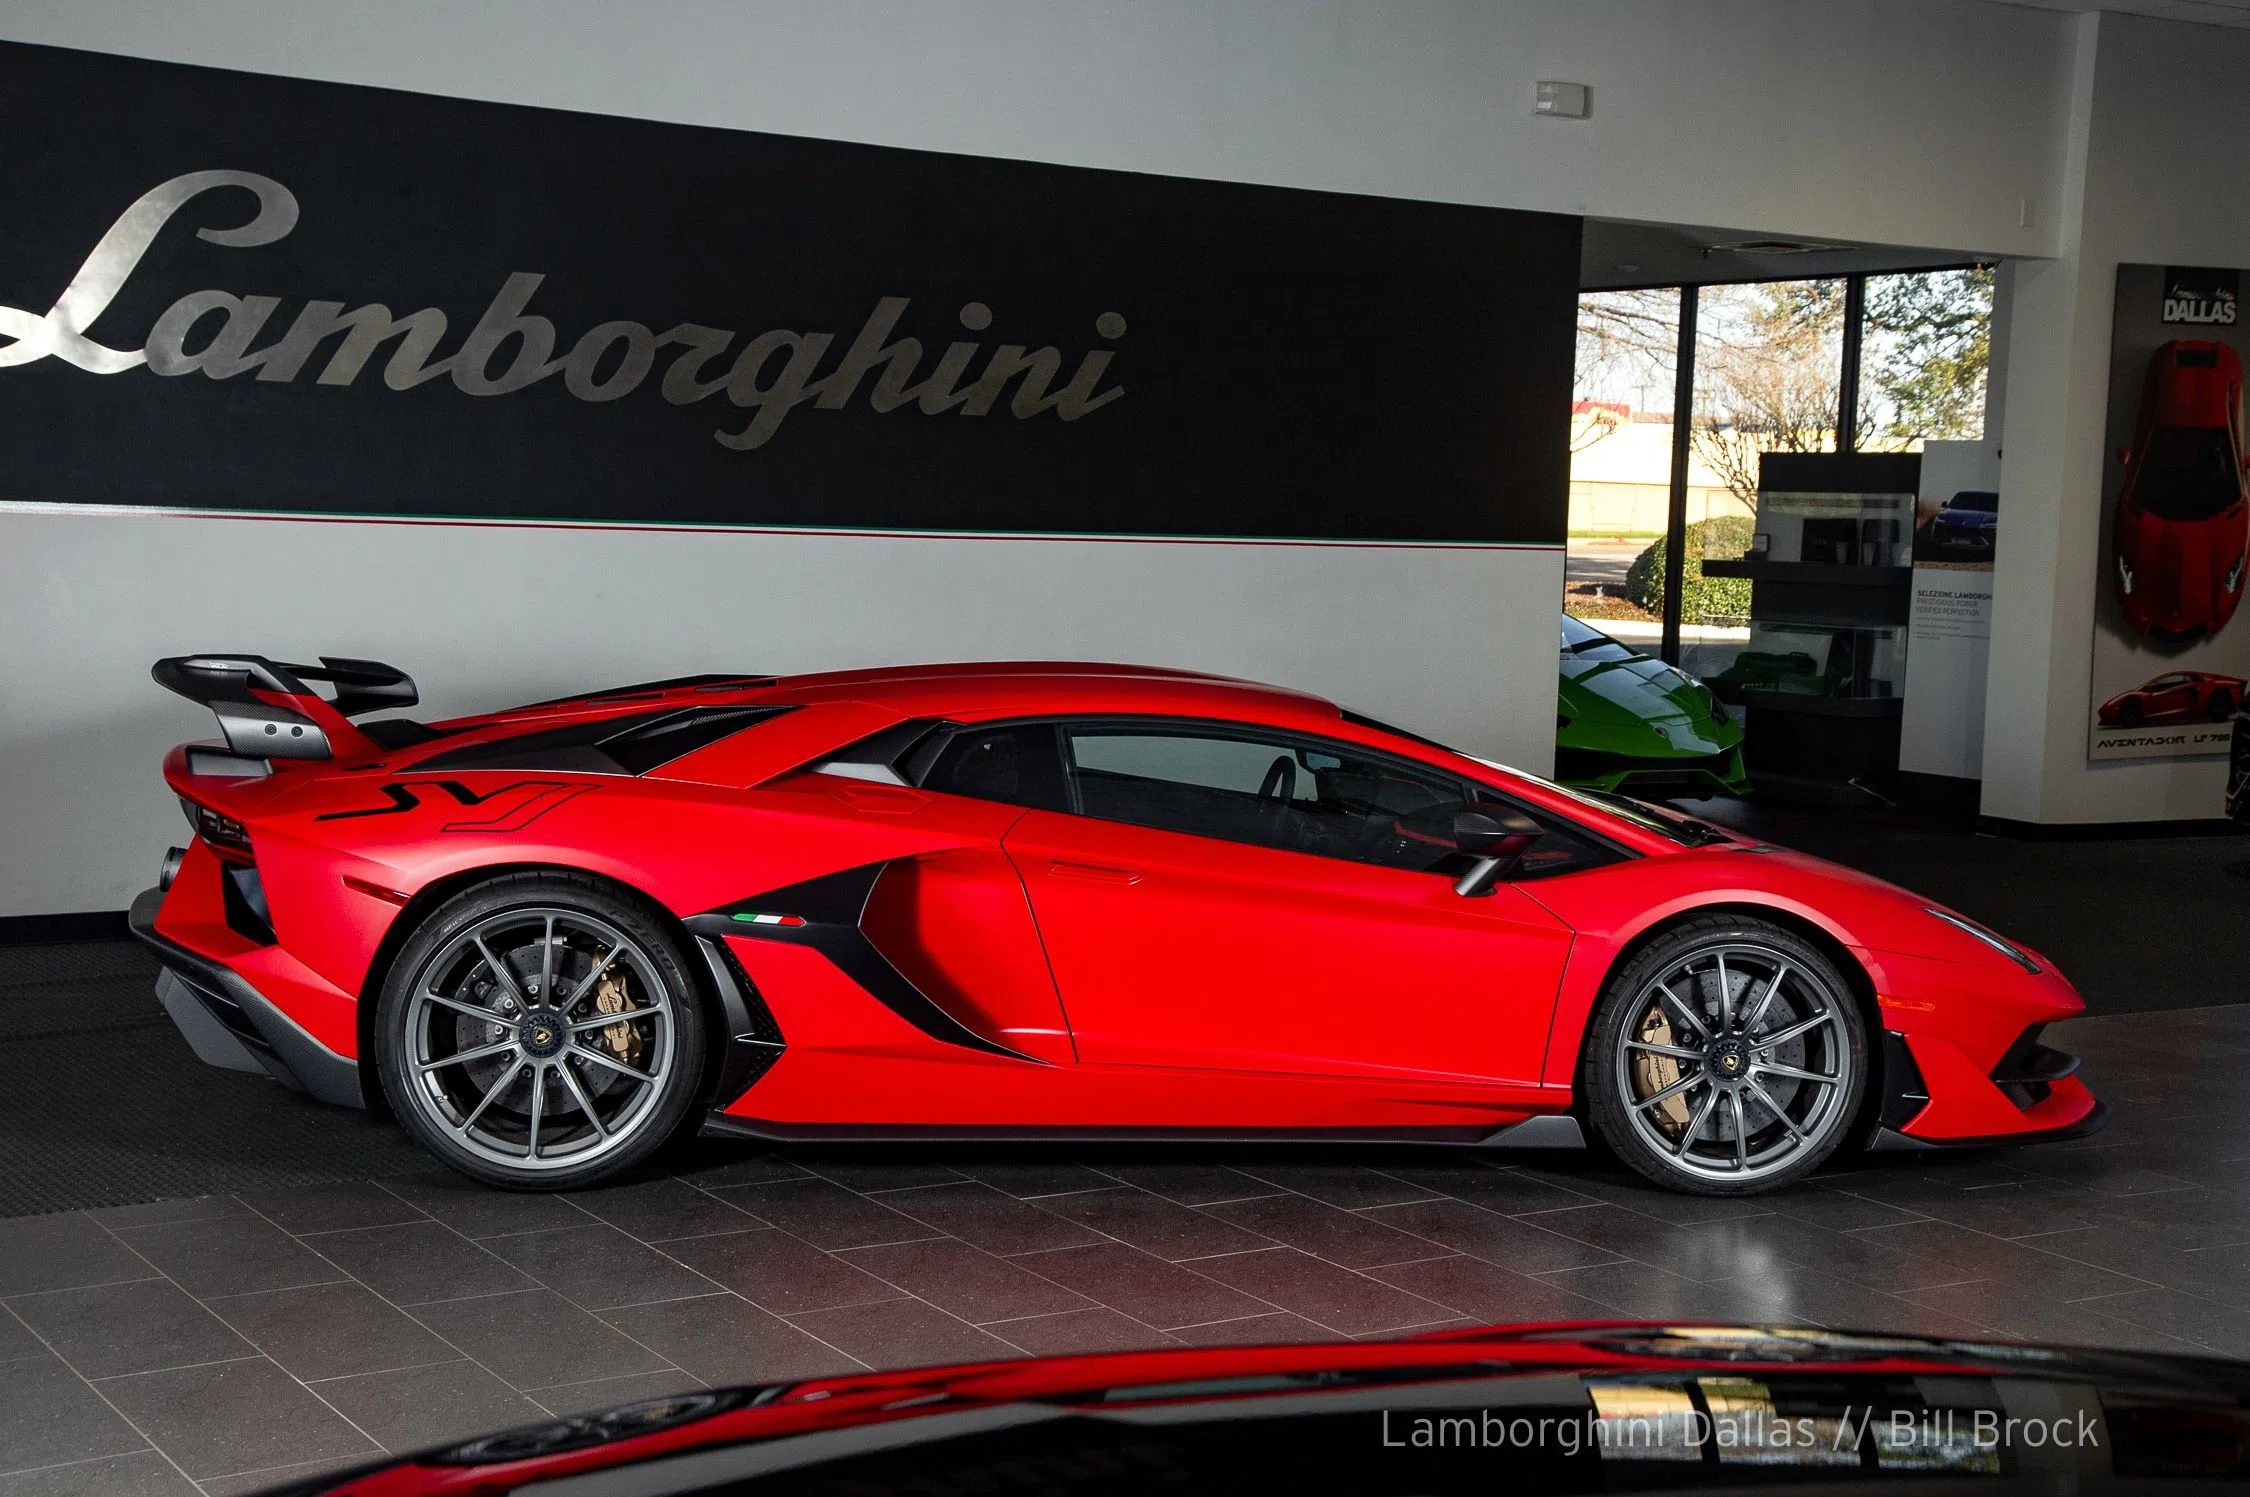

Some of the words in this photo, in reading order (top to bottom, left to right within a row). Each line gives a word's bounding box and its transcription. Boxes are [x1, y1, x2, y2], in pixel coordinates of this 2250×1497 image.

[0, 169, 1125, 451] Lamborghini
[2163, 299, 2236, 324] DALLAS
[1917, 590, 1953, 598] SELEZIONE
